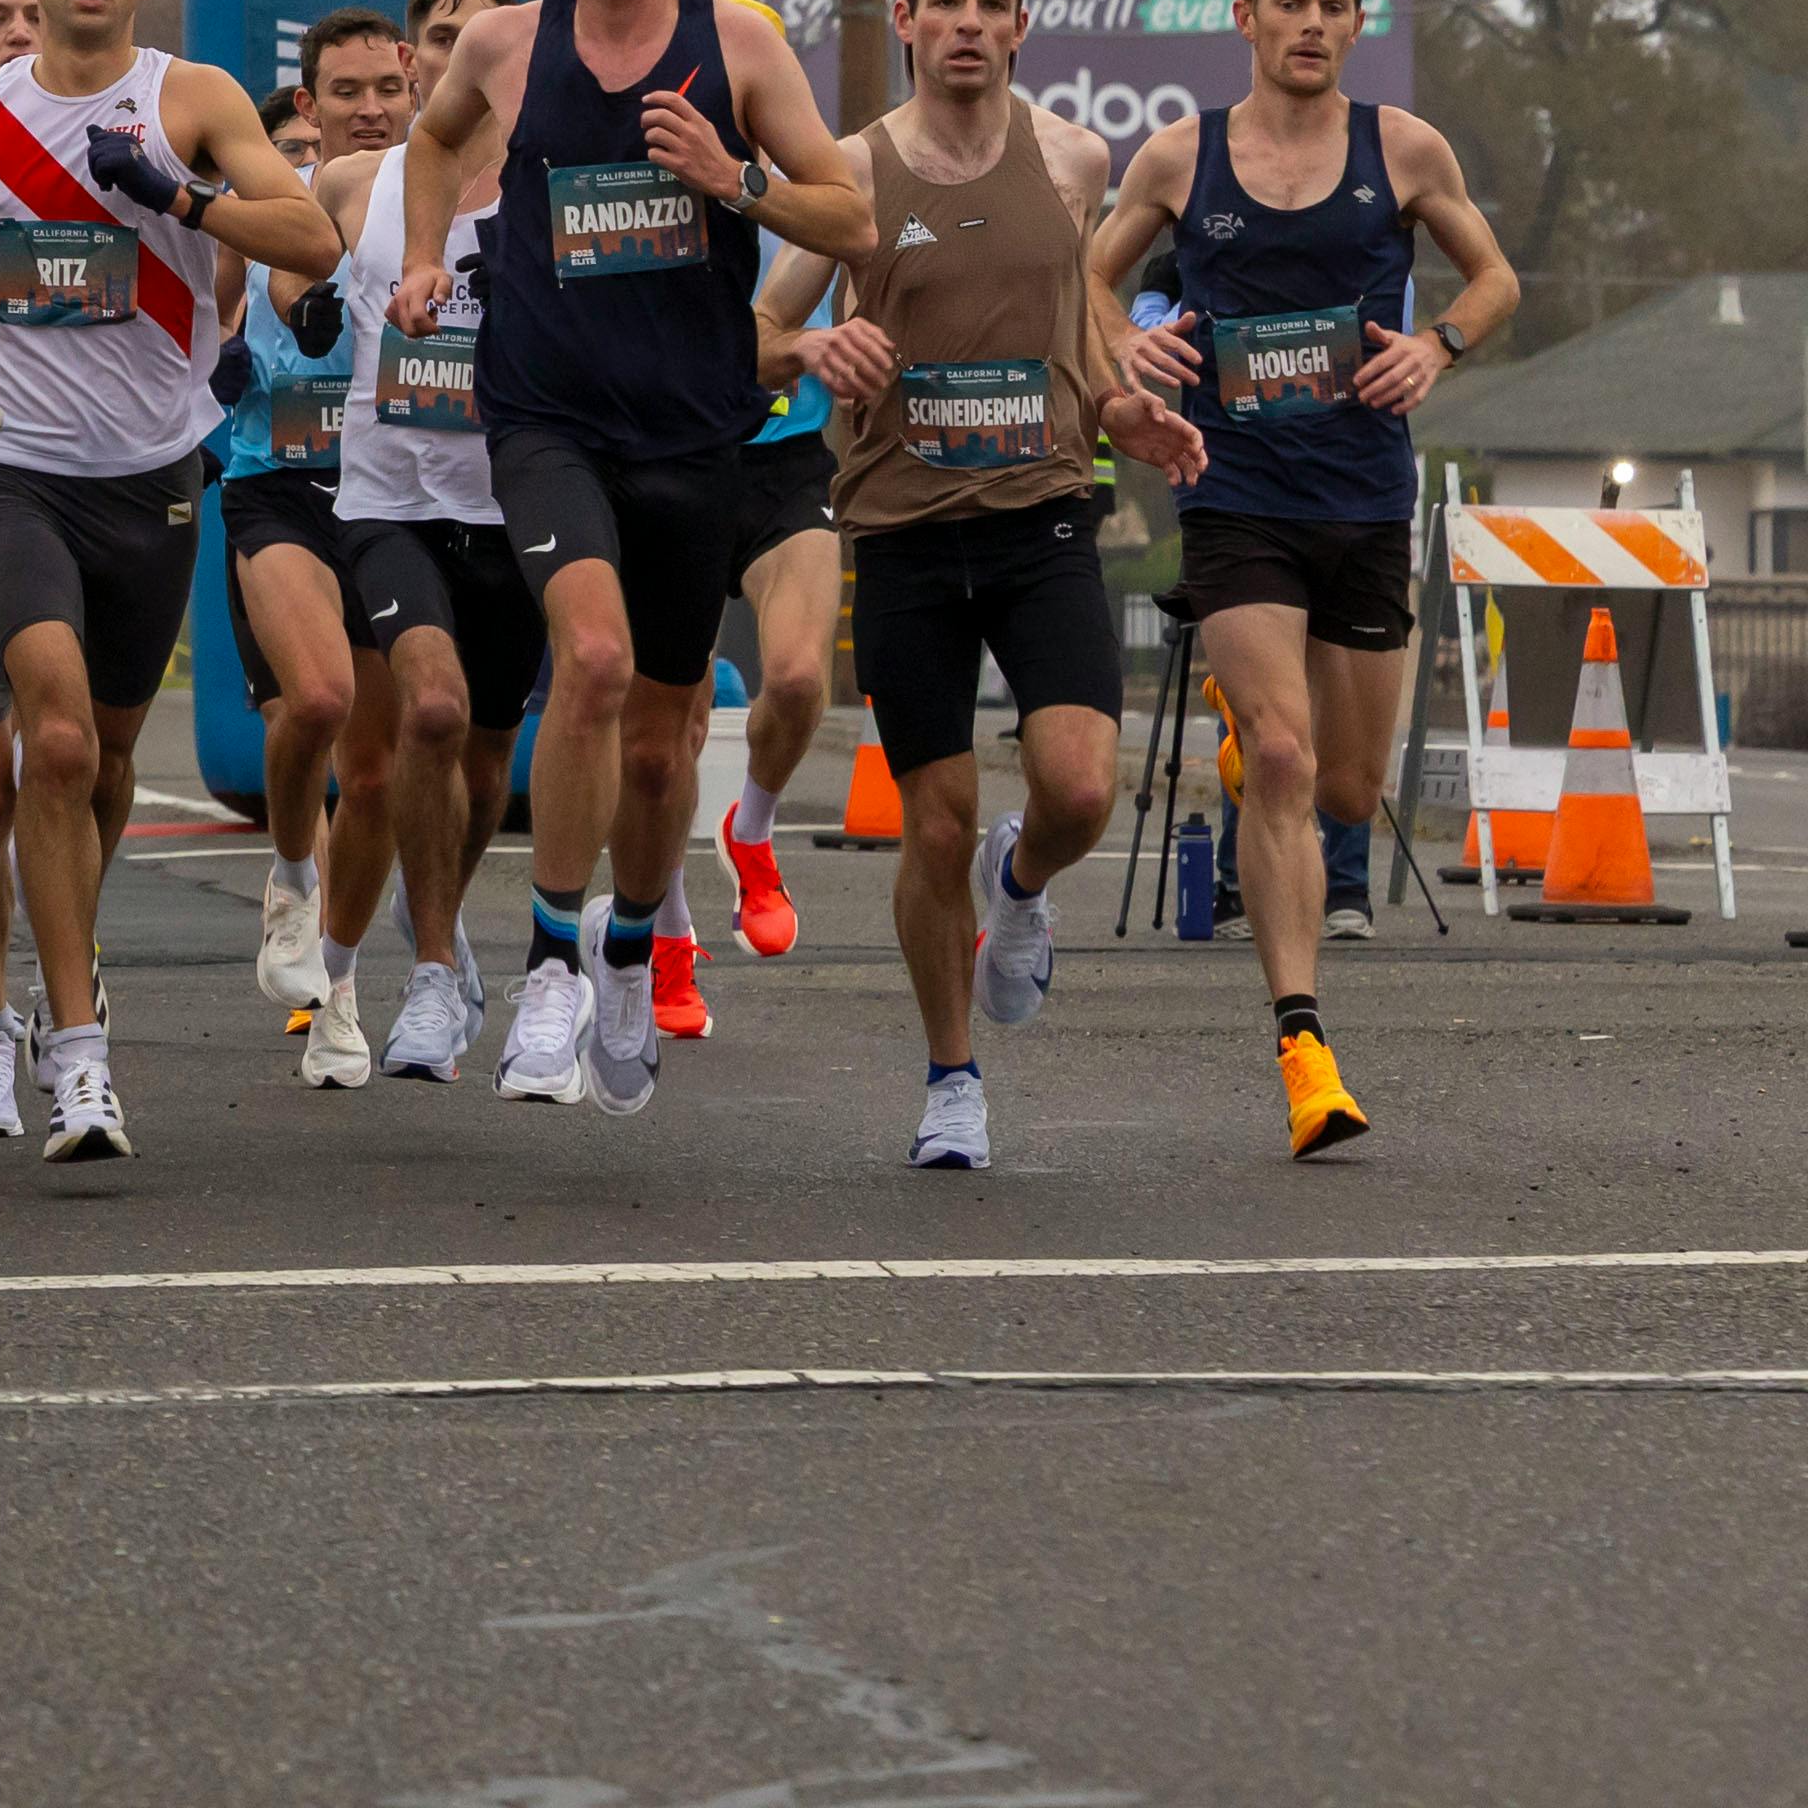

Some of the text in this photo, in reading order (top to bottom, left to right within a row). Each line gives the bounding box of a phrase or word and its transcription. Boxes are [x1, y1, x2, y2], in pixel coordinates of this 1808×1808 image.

[1008, 67, 1201, 140] doo
[596, 169, 654, 182] CALIFORNIA
[563, 195, 694, 235] RANDAZZO
[33, 229, 89, 238] CALIFORNIA
[94, 234, 114, 243] CIM
[571, 256, 597, 266] ELITE
[37, 258, 87, 287] RITZ
[1256, 320, 1335, 333] CALIFORNIA CIM
[1248, 345, 1330, 381] HOUGH
[398, 357, 474, 391] IOANID
[946, 369, 1027, 382] CALIFORNIA CIM
[312, 381, 352, 389] CALIFOR
[388, 398, 410, 407] 2025
[1235, 395, 1258, 405] 2025
[388, 406, 411, 415] ELITE
[907, 395, 1044, 427] SCHNEIDERMAN
[1236, 402, 1260, 412] ELITE
[285, 451, 307, 459] ELITE
